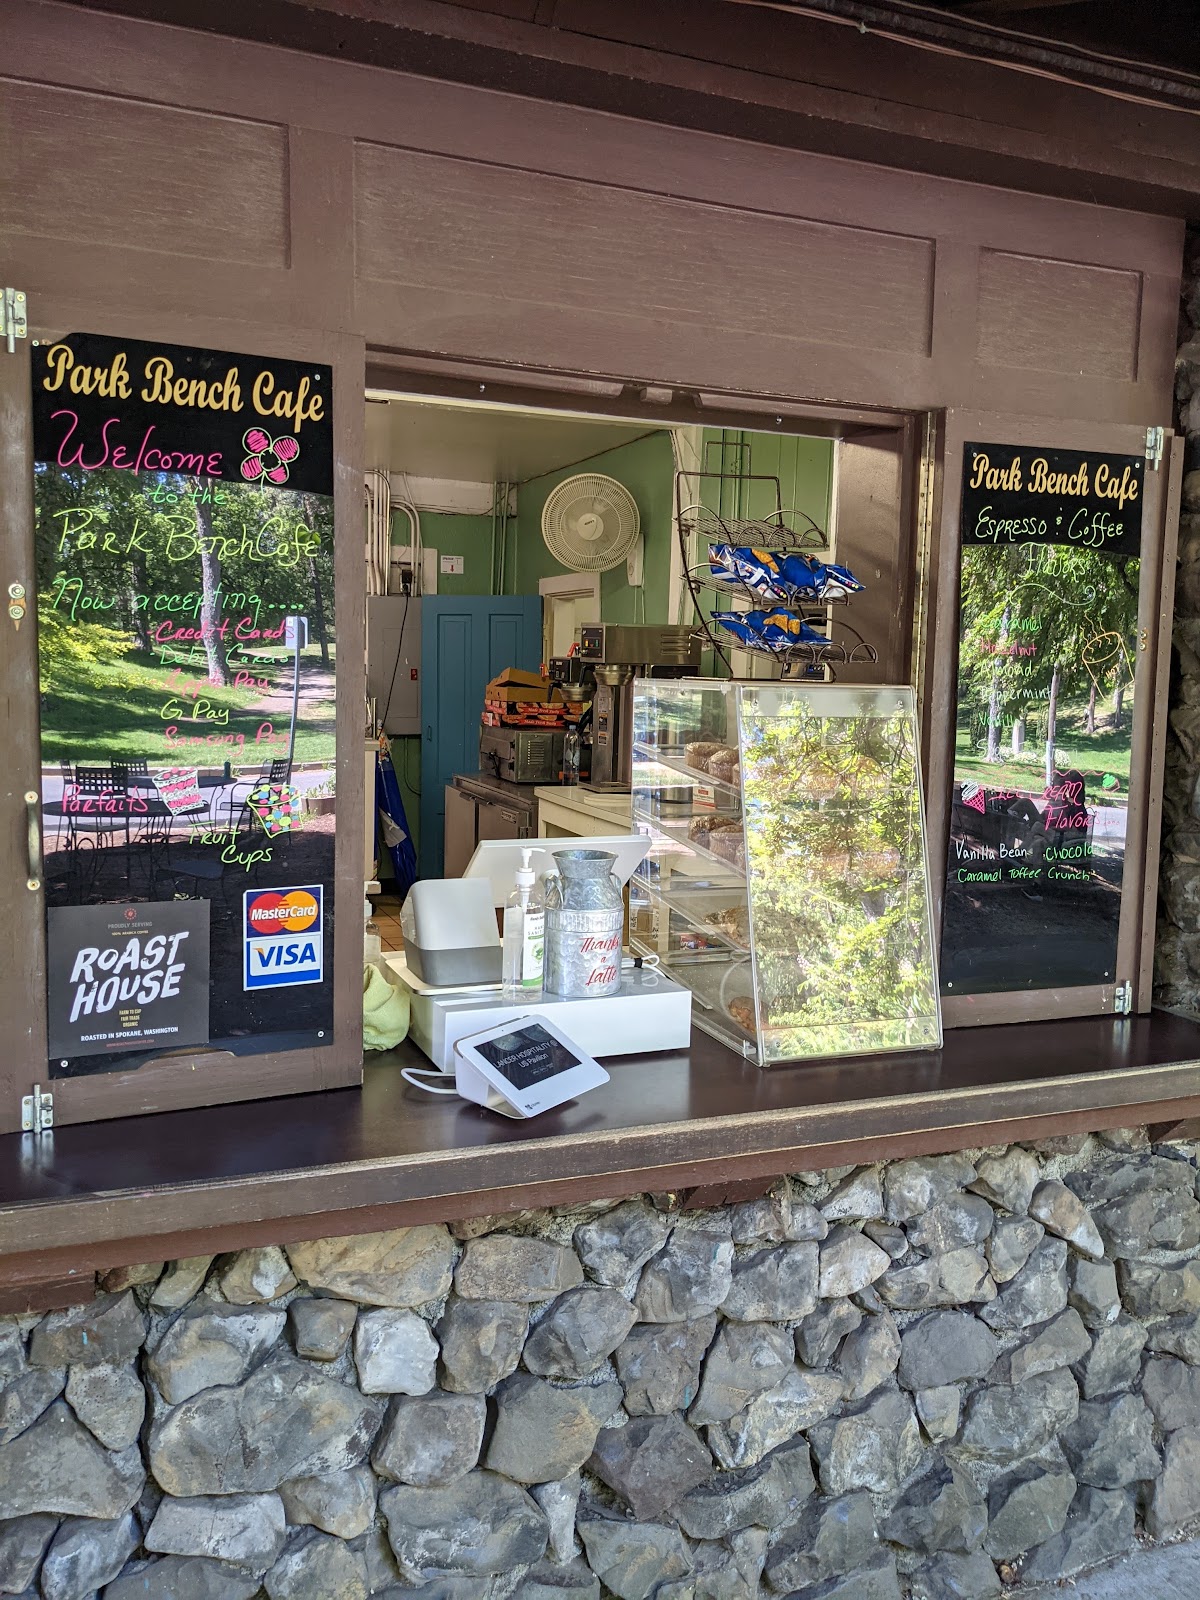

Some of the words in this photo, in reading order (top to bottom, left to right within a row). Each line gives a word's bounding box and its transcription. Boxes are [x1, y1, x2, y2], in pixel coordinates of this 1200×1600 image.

[43, 344, 132, 400] Park
[140, 356, 244, 412] Bench
[252, 371, 325, 433] Cafe
[50, 410, 223, 476] Welcome
[149, 483, 178, 504] to
[188, 487, 227, 505] the
[970, 453, 1023, 492] Park
[1027, 457, 1090, 497] Bench
[1094, 463, 1139, 510] Cafe
[53, 508, 152, 554] Park
[1068, 507, 1124, 548] Coffee
[53, 577, 116, 622] Now
[235, 617, 295, 640] Cards
[234, 670, 270, 694] Pay
[192, 699, 229, 725] Pay
[255, 722, 290, 754] Pay
[62, 784, 148, 813] Parfaits
[187, 820, 241, 845] Fruit
[221, 844, 273, 872] Cups
[955, 839, 996, 860] Vanilla
[999, 843, 1028, 859] Bean
[1045, 841, 1106, 861] Chocolae
[957, 868, 1002, 883] Caramel
[1048, 866, 1091, 881] Crunch
[249, 904, 317, 922] MasterCard
[254, 942, 317, 968] VISA
[579, 933, 620, 953] Thanks
[69, 931, 189, 984] ROAST
[585, 965, 617, 986] Latte
[69, 963, 186, 1023] HOUSE
[80, 1033, 107, 1042] ROASTED
[115, 1029, 142, 1038] SPOKANE,
[143, 1026, 178, 1036] WASHINGTON
[493, 1054, 518, 1069] LANCER
[516, 1041, 551, 1059] HOSPITALITY
[518, 1060, 529, 1069] US
[527, 1053, 549, 1065] Pavilion
